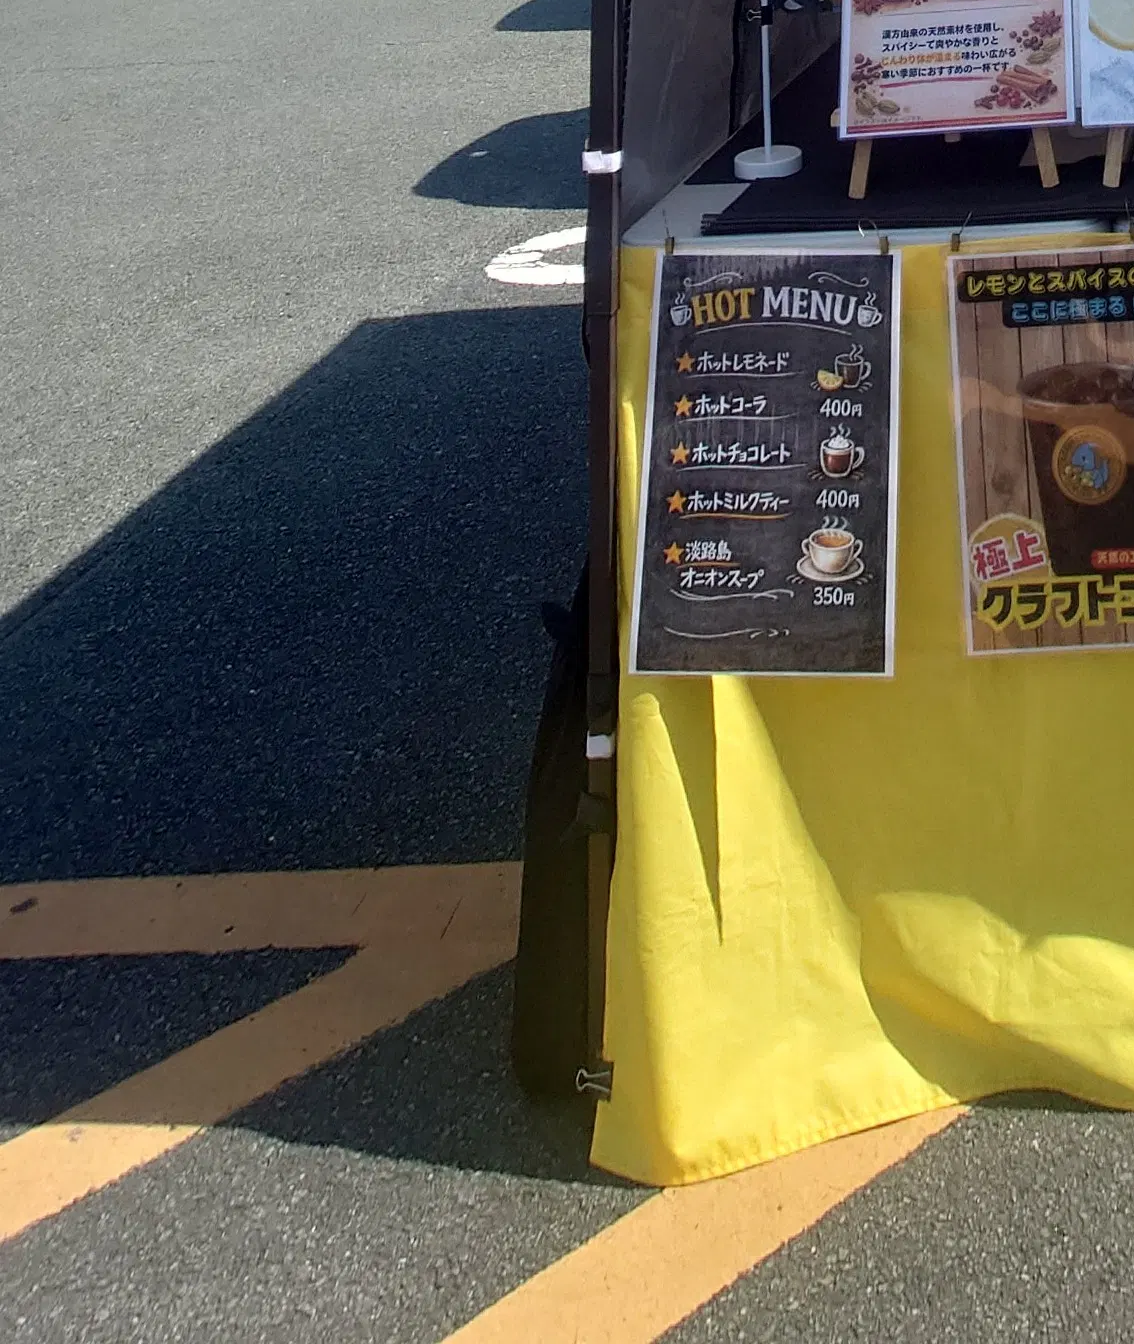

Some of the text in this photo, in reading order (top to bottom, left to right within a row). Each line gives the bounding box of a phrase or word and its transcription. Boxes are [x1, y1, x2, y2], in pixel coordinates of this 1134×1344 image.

[690, 285, 859, 328] HOT MENU
[696, 350, 791, 375] ホットレモネード
[694, 394, 769, 415] ホットコーラ
[819, 397, 863, 418] 400円
[690, 441, 791, 464] ホットチョコレート
[686, 491, 790, 512] ホットミルクティー
[815, 488, 860, 510] 400円
[684, 540, 733, 563] 淡路島
[970, 530, 1048, 581] 極上
[679, 569, 766, 590] オニオンスープ
[813, 586, 856, 608] 350円
